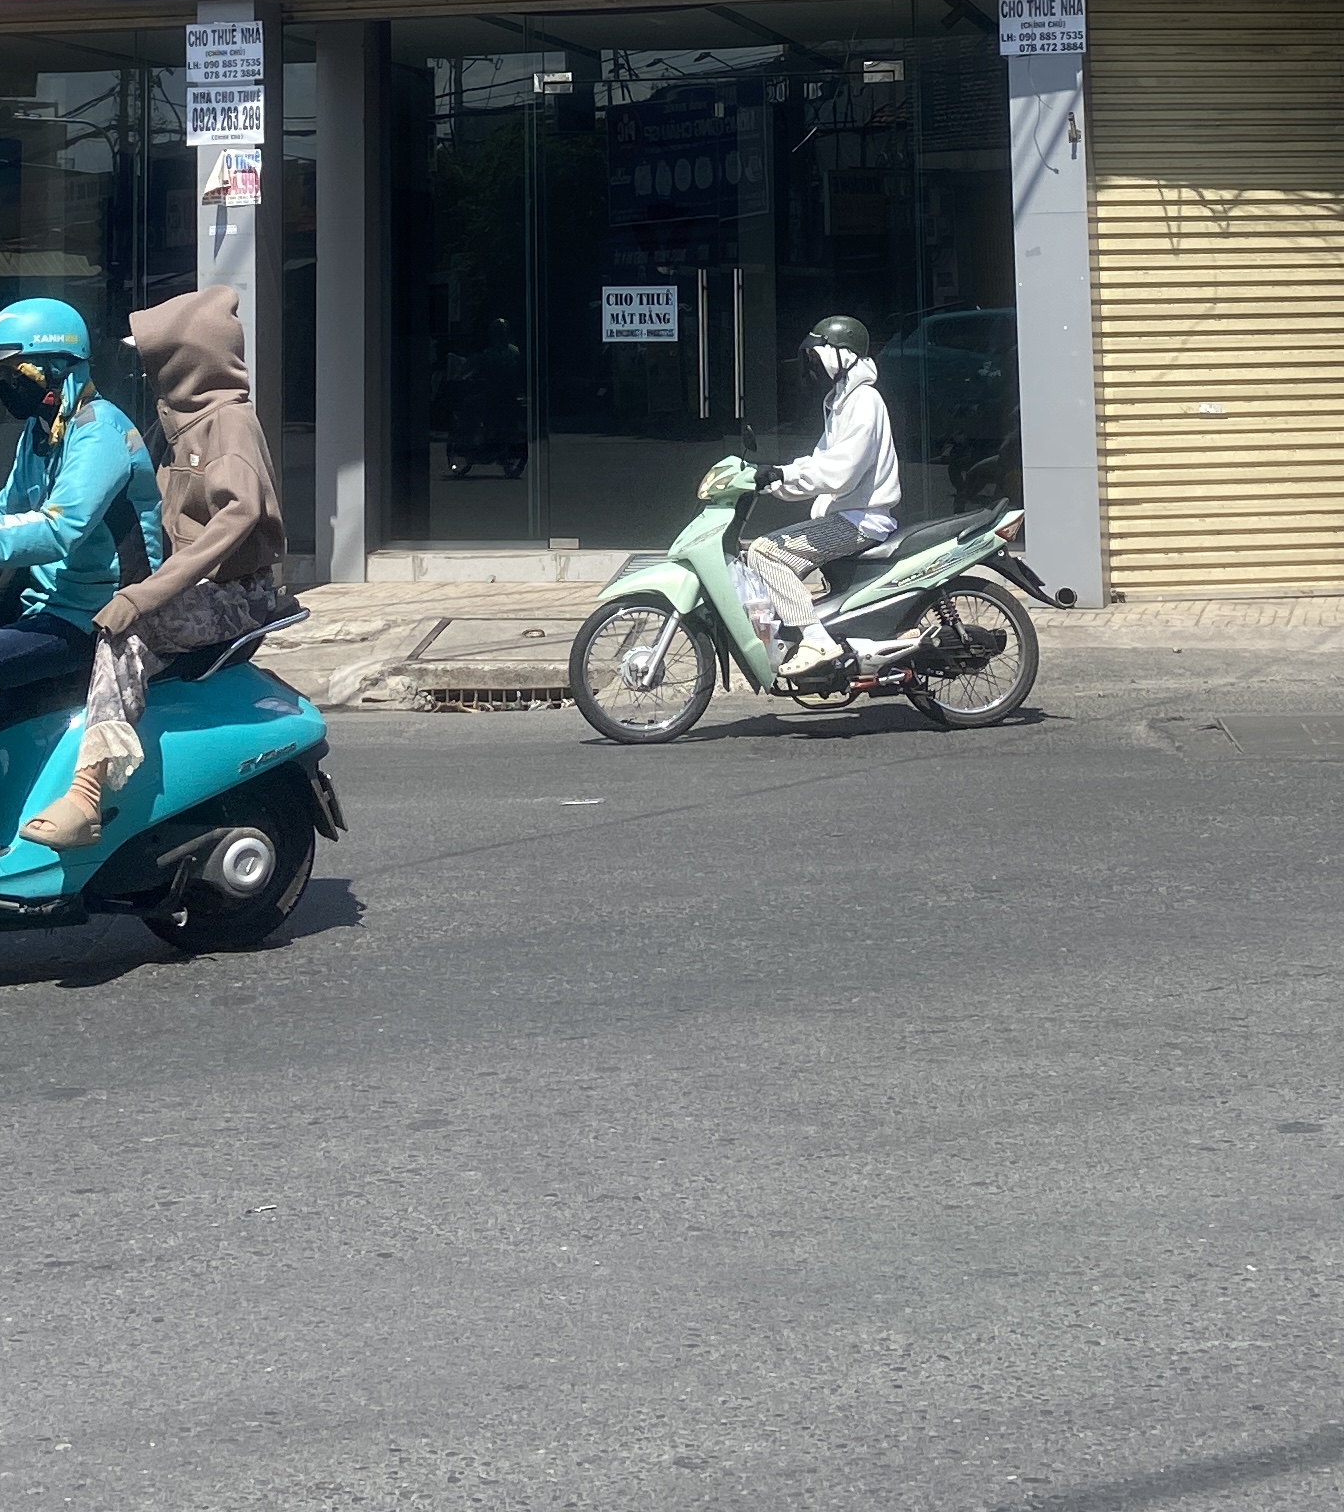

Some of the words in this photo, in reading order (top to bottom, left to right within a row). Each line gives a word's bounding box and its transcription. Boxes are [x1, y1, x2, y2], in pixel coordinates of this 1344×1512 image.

[1001, 0, 1024, 19] CHO
[188, 30, 208, 48] CHO
[211, 24, 237, 47] THUÊ
[240, 22, 262, 45] NHÀ
[1001, 33, 1017, 42] LH:
[1019, 32, 1036, 41] 090
[1039, 31, 1057, 41] 885
[1060, 31, 1084, 40] 7535
[1019, 44, 1037, 52] 078
[1040, 43, 1058, 52] 472
[1060, 42, 1084, 51] 3884
[187, 62, 201, 70] LH:
[204, 60, 220, 69] 090
[222, 59, 238, 68] 885
[240, 58, 262, 67] 7535
[204, 71, 221, 80] 078
[222, 70, 238, 79] 472
[192, 89, 213, 104] NHÀ
[215, 90, 235, 104] CHO
[237, 88, 262, 103] THUÊ
[192, 105, 261, 132] 0923.263.289
[606, 292, 634, 307] CHO
[636, 288, 674, 306] THUÊ
[610, 309, 636, 328] MẶT
[638, 306, 671, 325] BẰNG
[33, 334, 65, 343] XANH
